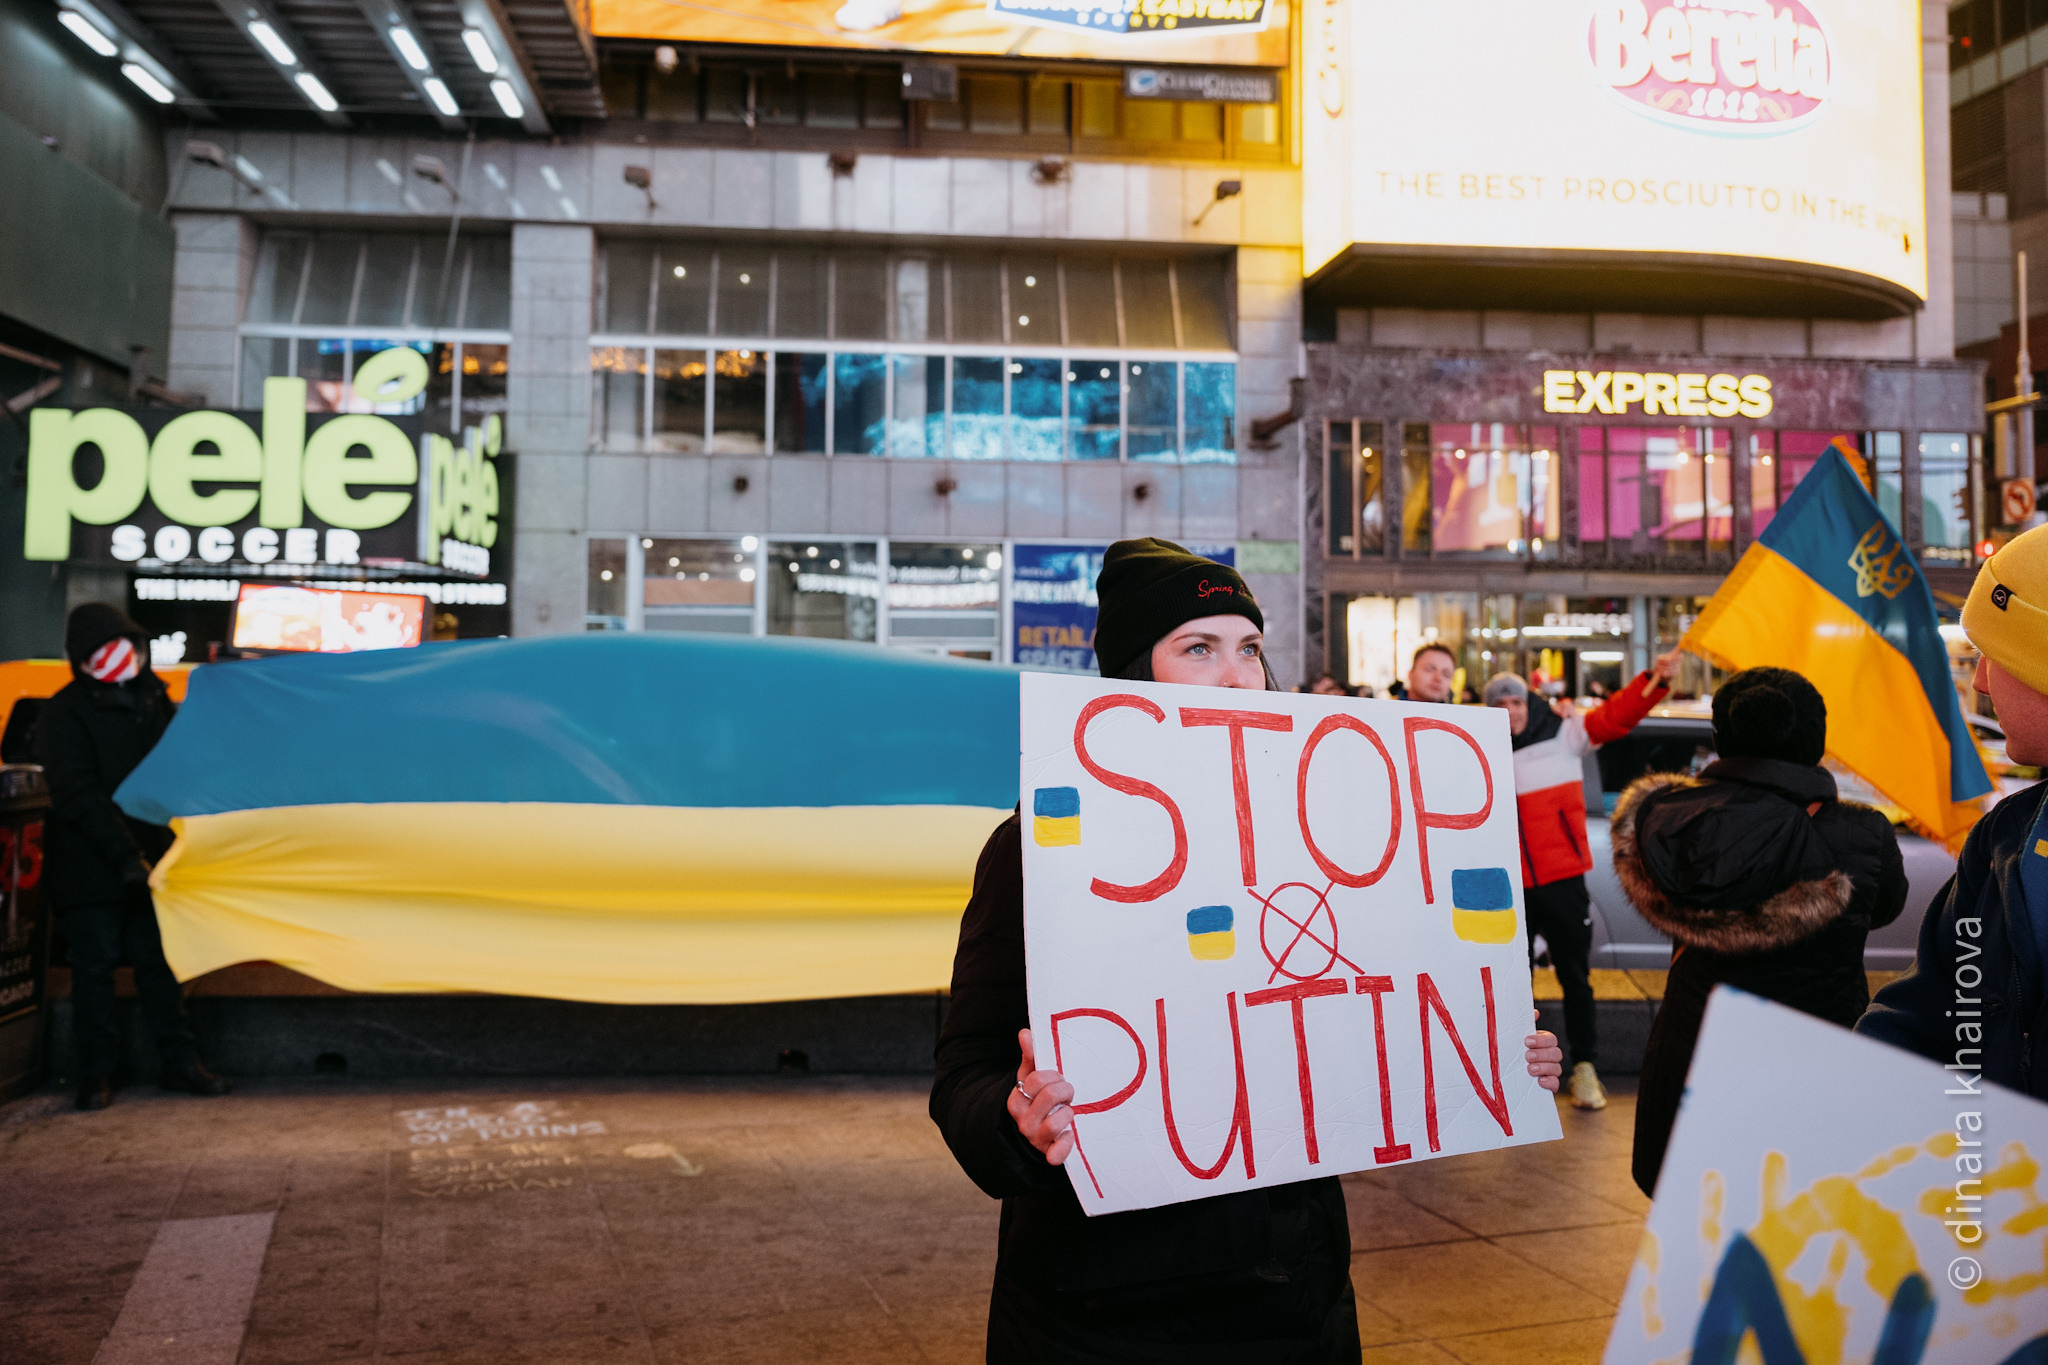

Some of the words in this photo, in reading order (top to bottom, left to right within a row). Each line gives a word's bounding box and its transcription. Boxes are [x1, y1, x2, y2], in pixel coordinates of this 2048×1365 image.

[1688, 87, 1760, 121] 1812
[1375, 170, 1444, 198] THE
[1458, 173, 1546, 200] BEST
[1563, 176, 1782, 213] PROSCIUTTO
[1792, 192, 1818, 217] IN
[1827, 197, 1867, 230] THE
[1543, 369, 1774, 418] EXPRESS
[24, 347, 429, 560] pelé
[110, 524, 361, 564] SOCCER
[1198, 579, 1234, 599] Spring
[1074, 693, 1494, 905] STOP
[1050, 966, 1514, 1199] PUTIN
